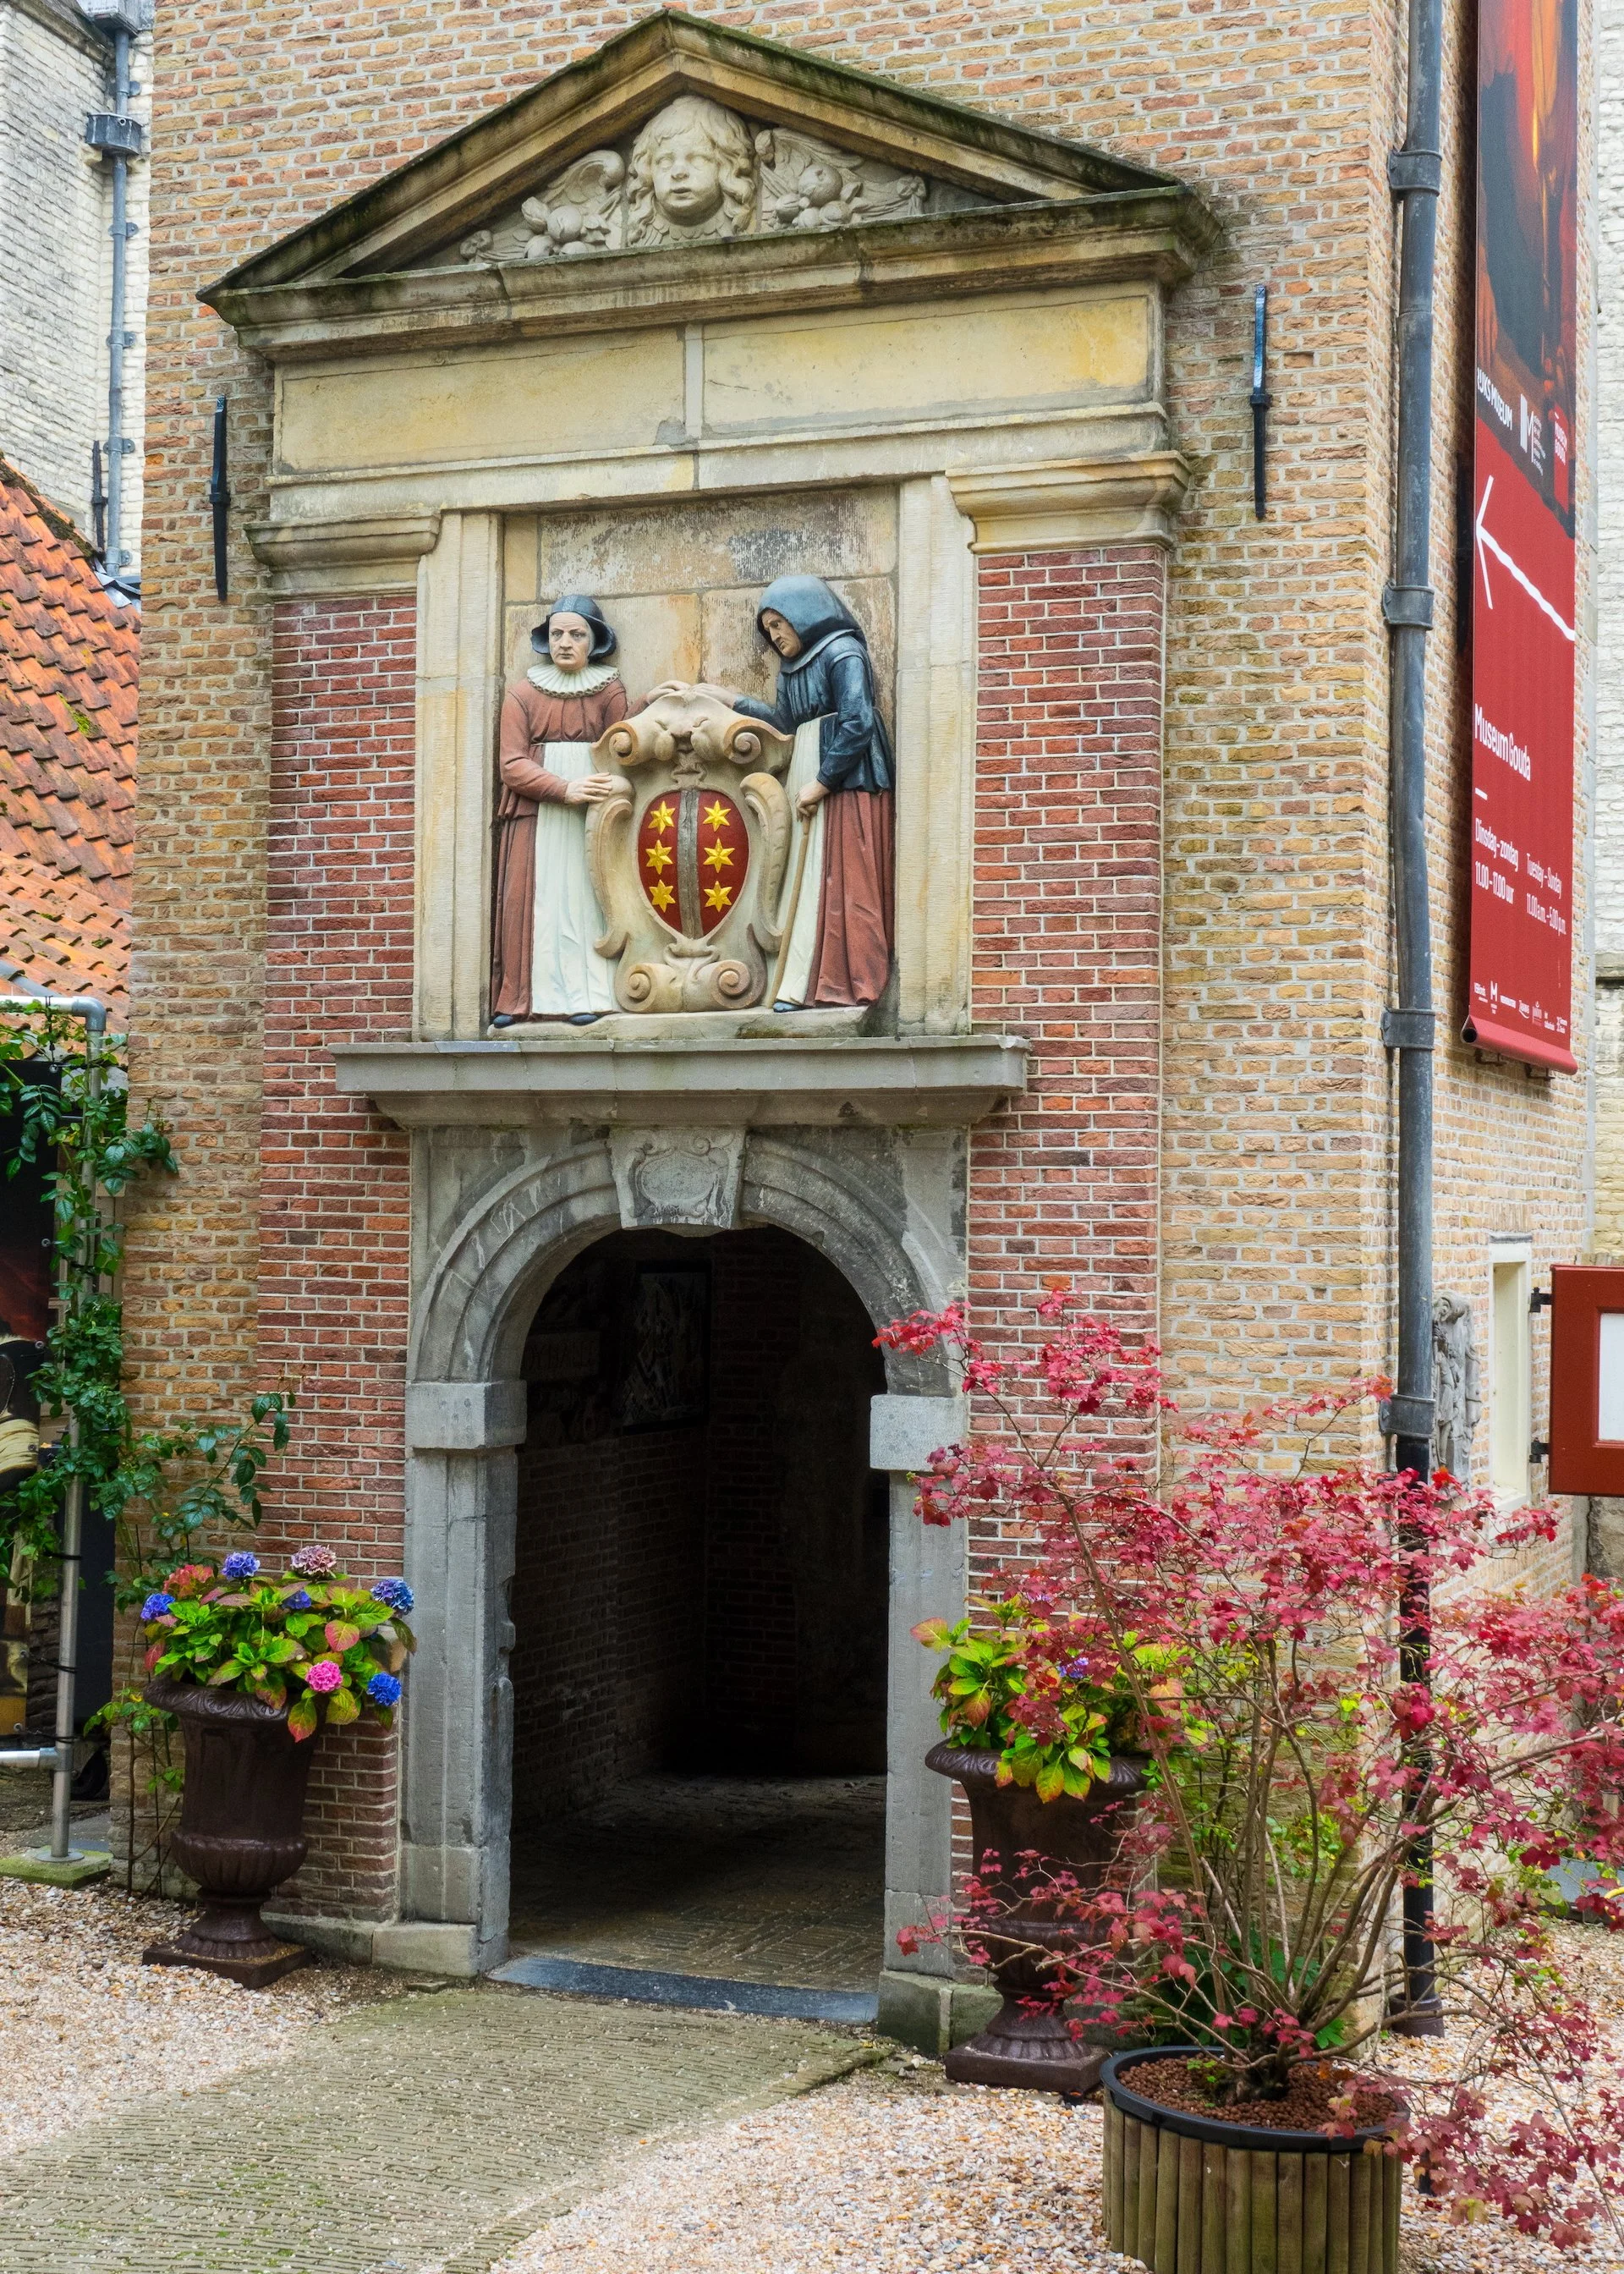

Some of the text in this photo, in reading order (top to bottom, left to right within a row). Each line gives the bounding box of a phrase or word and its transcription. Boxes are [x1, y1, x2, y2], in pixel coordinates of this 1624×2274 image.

[1475, 703, 1531, 781] Museum Gouda
[1475, 817, 1497, 859] Dinsdag
[1500, 840, 1518, 872] zondag
[1475, 860, 1490, 890] 11.00
[1527, 853, 1544, 888] Tuesday
[1548, 867, 1562, 899] Sunday
